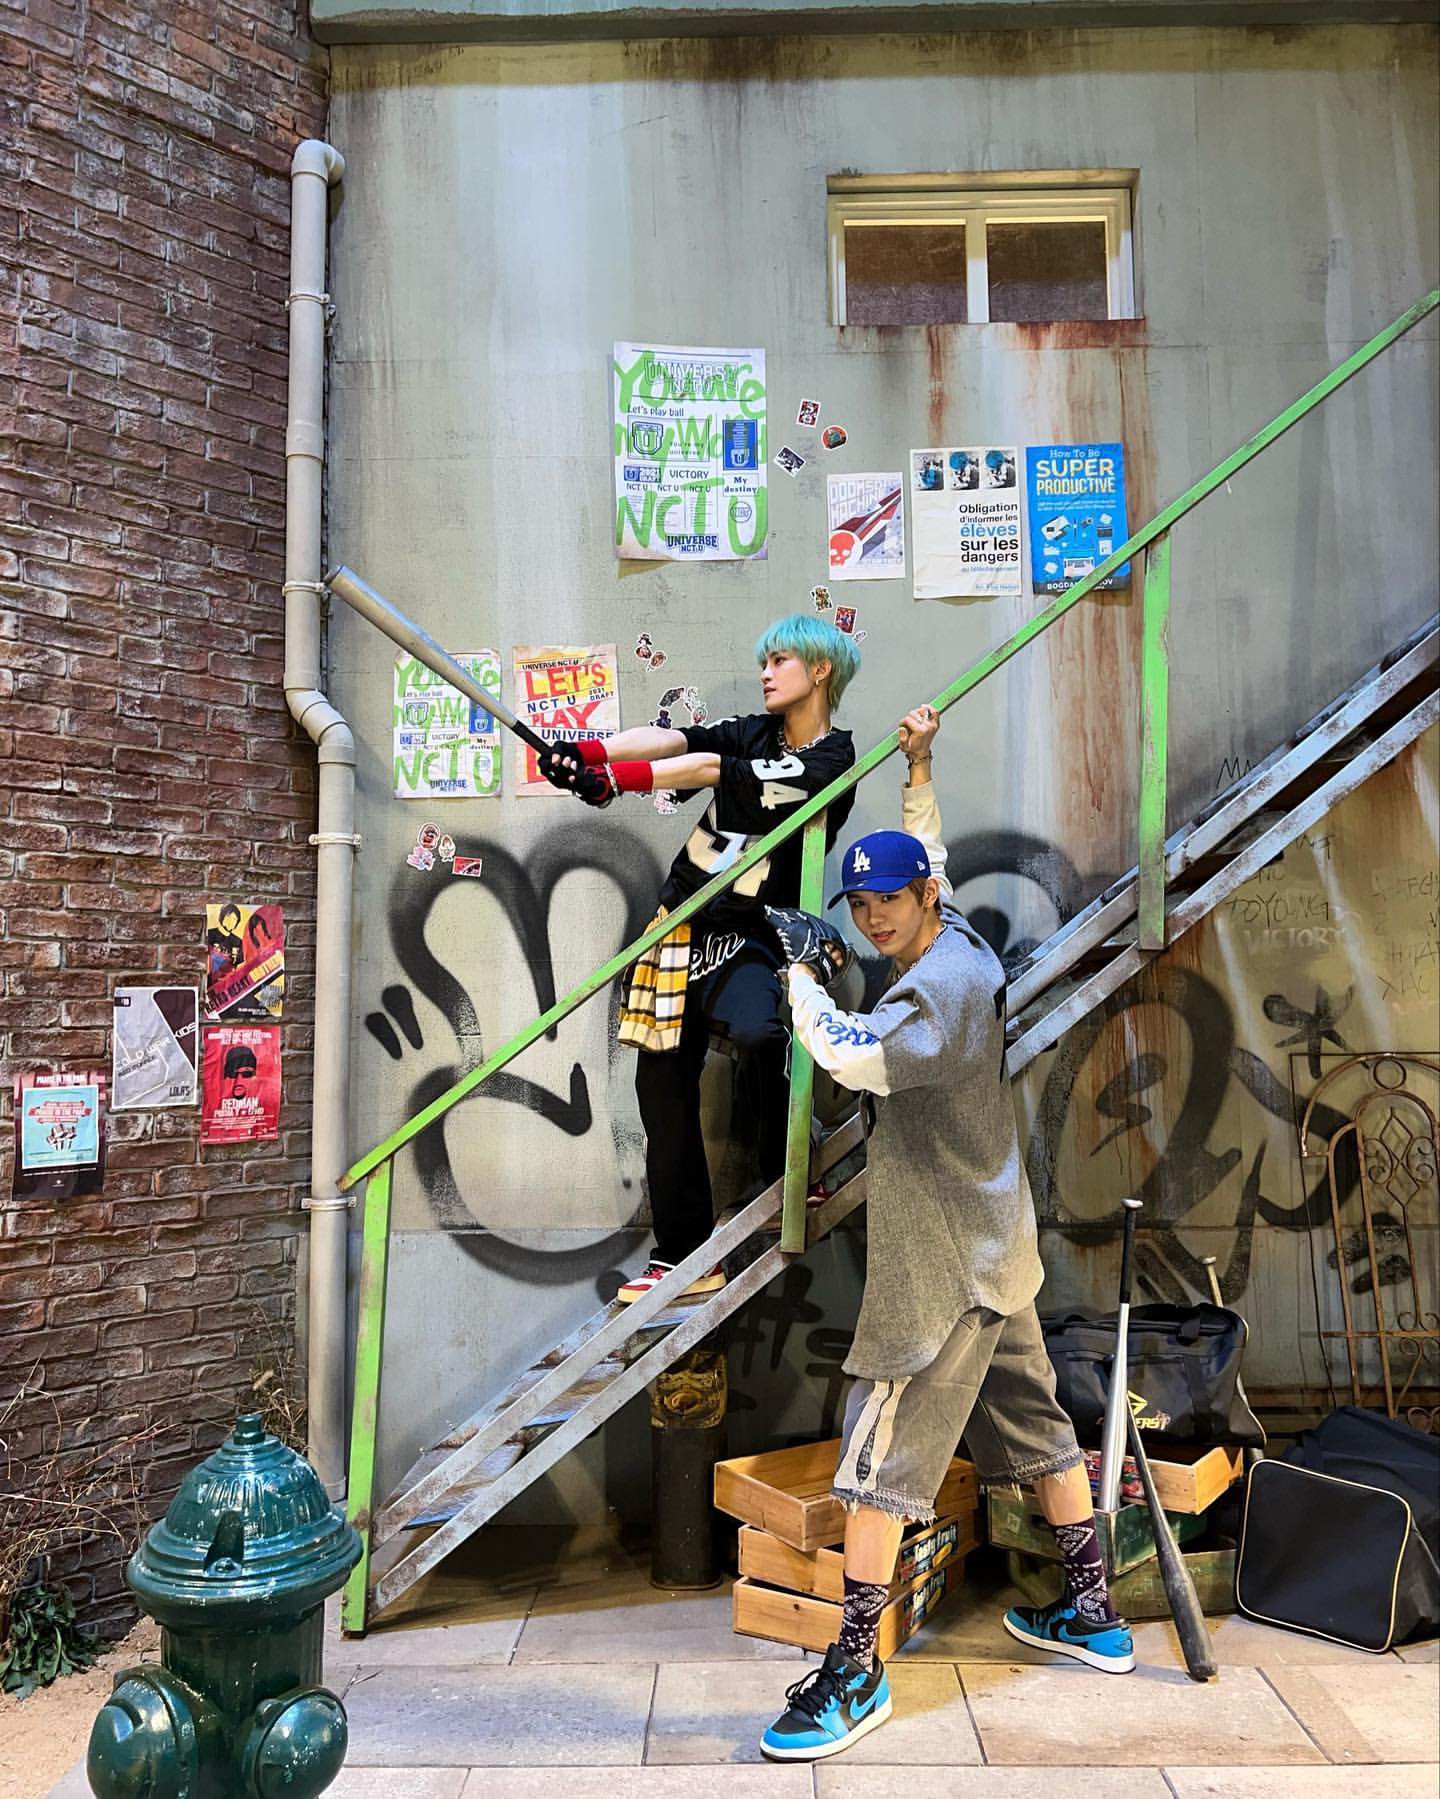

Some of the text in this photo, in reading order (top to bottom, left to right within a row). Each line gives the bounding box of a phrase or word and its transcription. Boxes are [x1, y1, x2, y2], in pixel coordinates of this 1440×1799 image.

[628, 405, 648, 414] Let's
[669, 407, 684, 417] ball
[1050, 450, 1070, 458] How
[669, 469, 709, 479] VICTORY
[1036, 458, 1115, 478] SUPER
[733, 476, 748, 485] My
[1036, 477, 1117, 496] PRODUCTIVE
[657, 484, 672, 492] NCT
[724, 486, 757, 494] destiny
[959, 503, 1018, 515] Obligation
[959, 513, 1018, 523] d'informer les
[960, 522, 1018, 538] élèves
[667, 534, 718, 547] UNIVERSE
[961, 536, 1019, 551] sur les
[961, 551, 1018, 564] dangers
[522, 662, 557, 671] UNIVERSE
[525, 662, 607, 701] LET'S
[590, 691, 614, 701] DRAFT
[527, 695, 577, 713] NCT U
[531, 700, 602, 729] PLAY
[852, 846, 872, 873] LA
[174, 1021, 197, 1039] KIDS
[169, 1085, 191, 1097] LOLA'S
